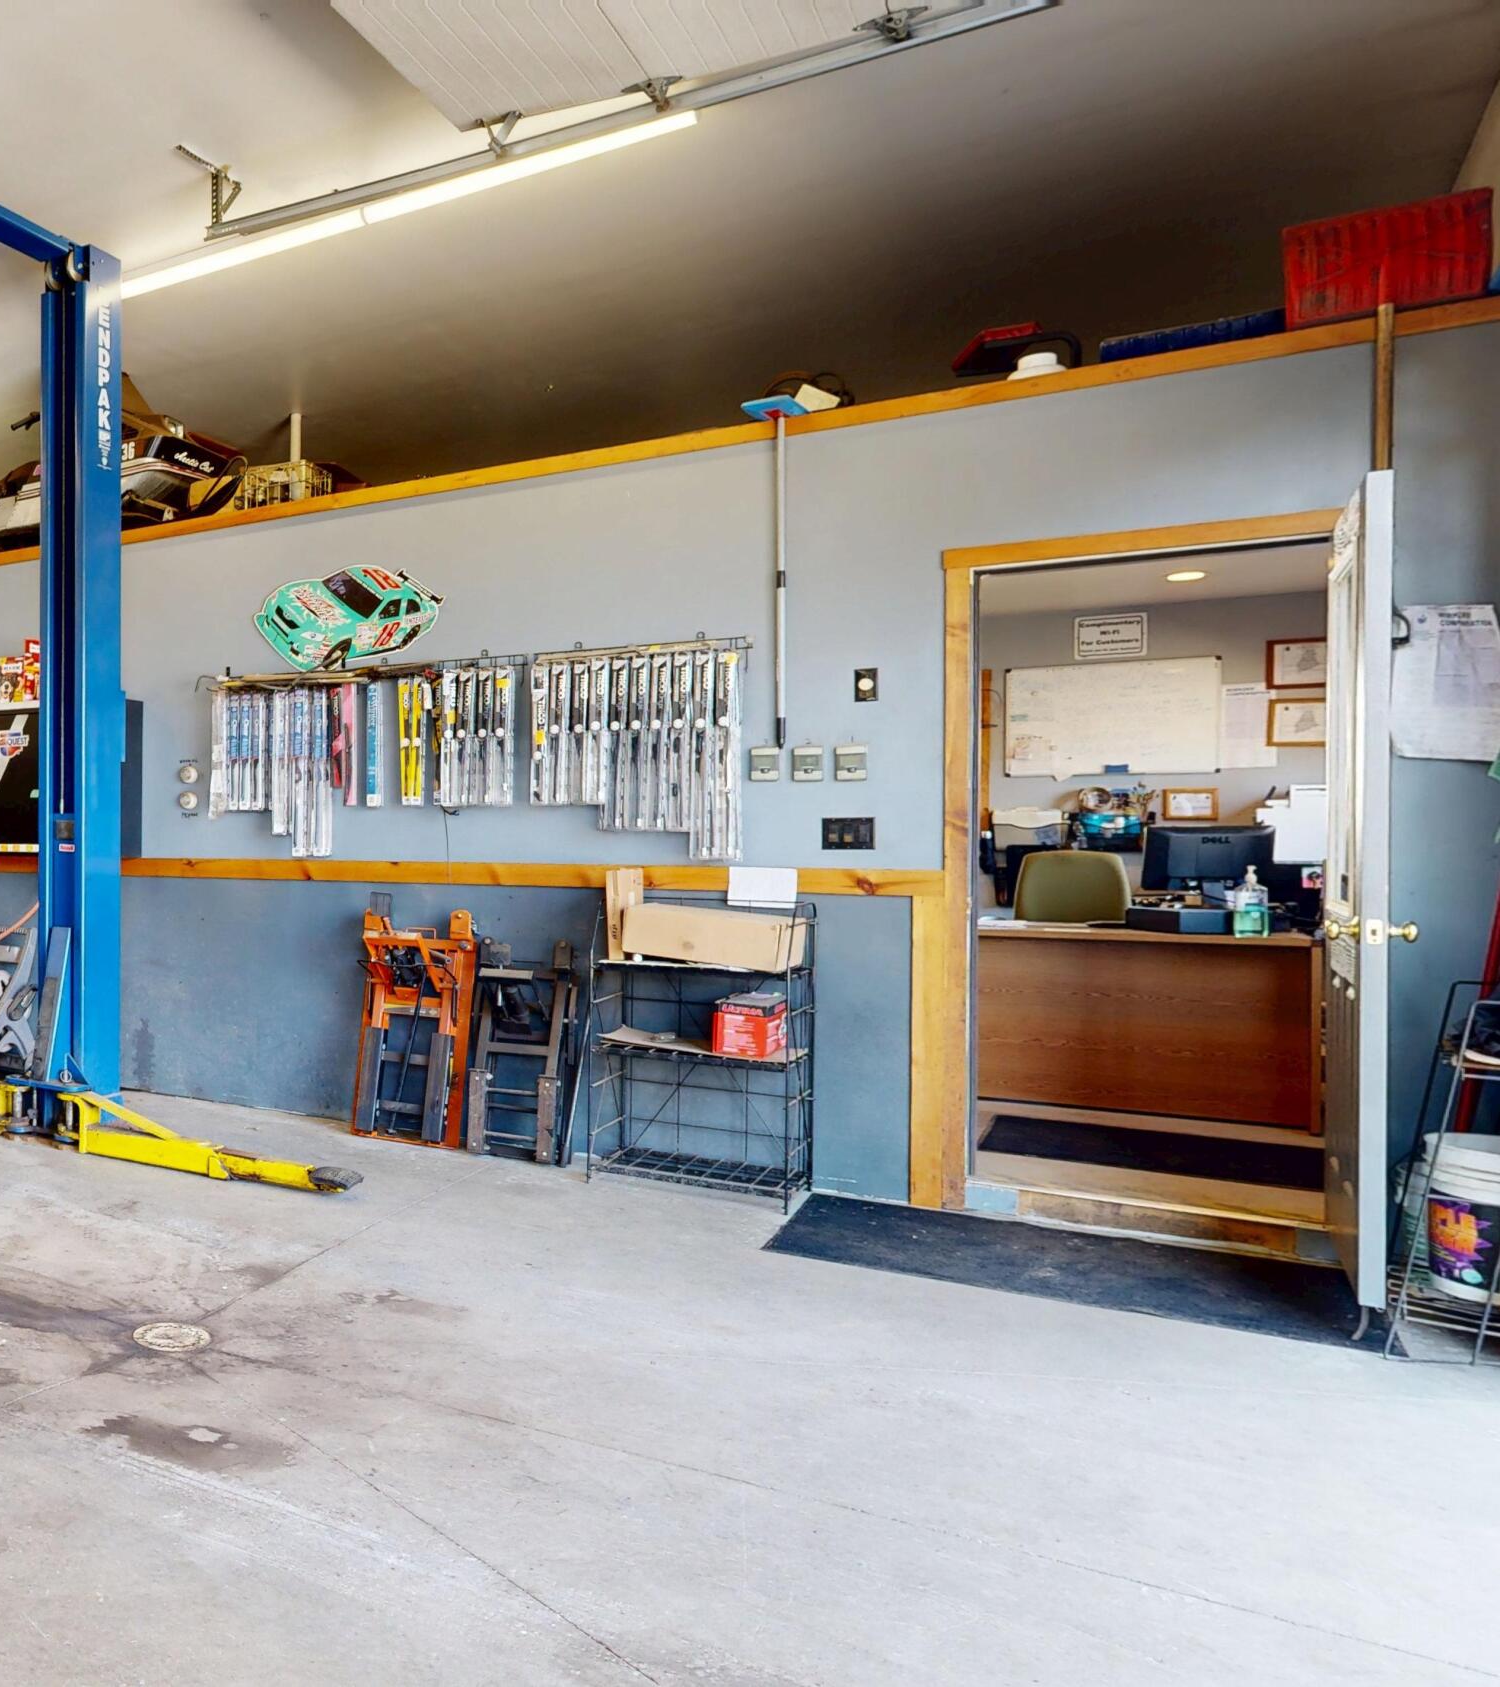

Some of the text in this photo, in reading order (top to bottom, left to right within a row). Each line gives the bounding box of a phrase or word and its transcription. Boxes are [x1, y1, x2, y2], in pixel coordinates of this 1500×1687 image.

[97, 303, 111, 431] ENDPAK
[121, 442, 135, 460] 36
[362, 568, 401, 590] 18
[1079, 620, 1140, 628] Complimentary
[372, 621, 401, 648] 18
[1202, 836, 1231, 845] DELL
